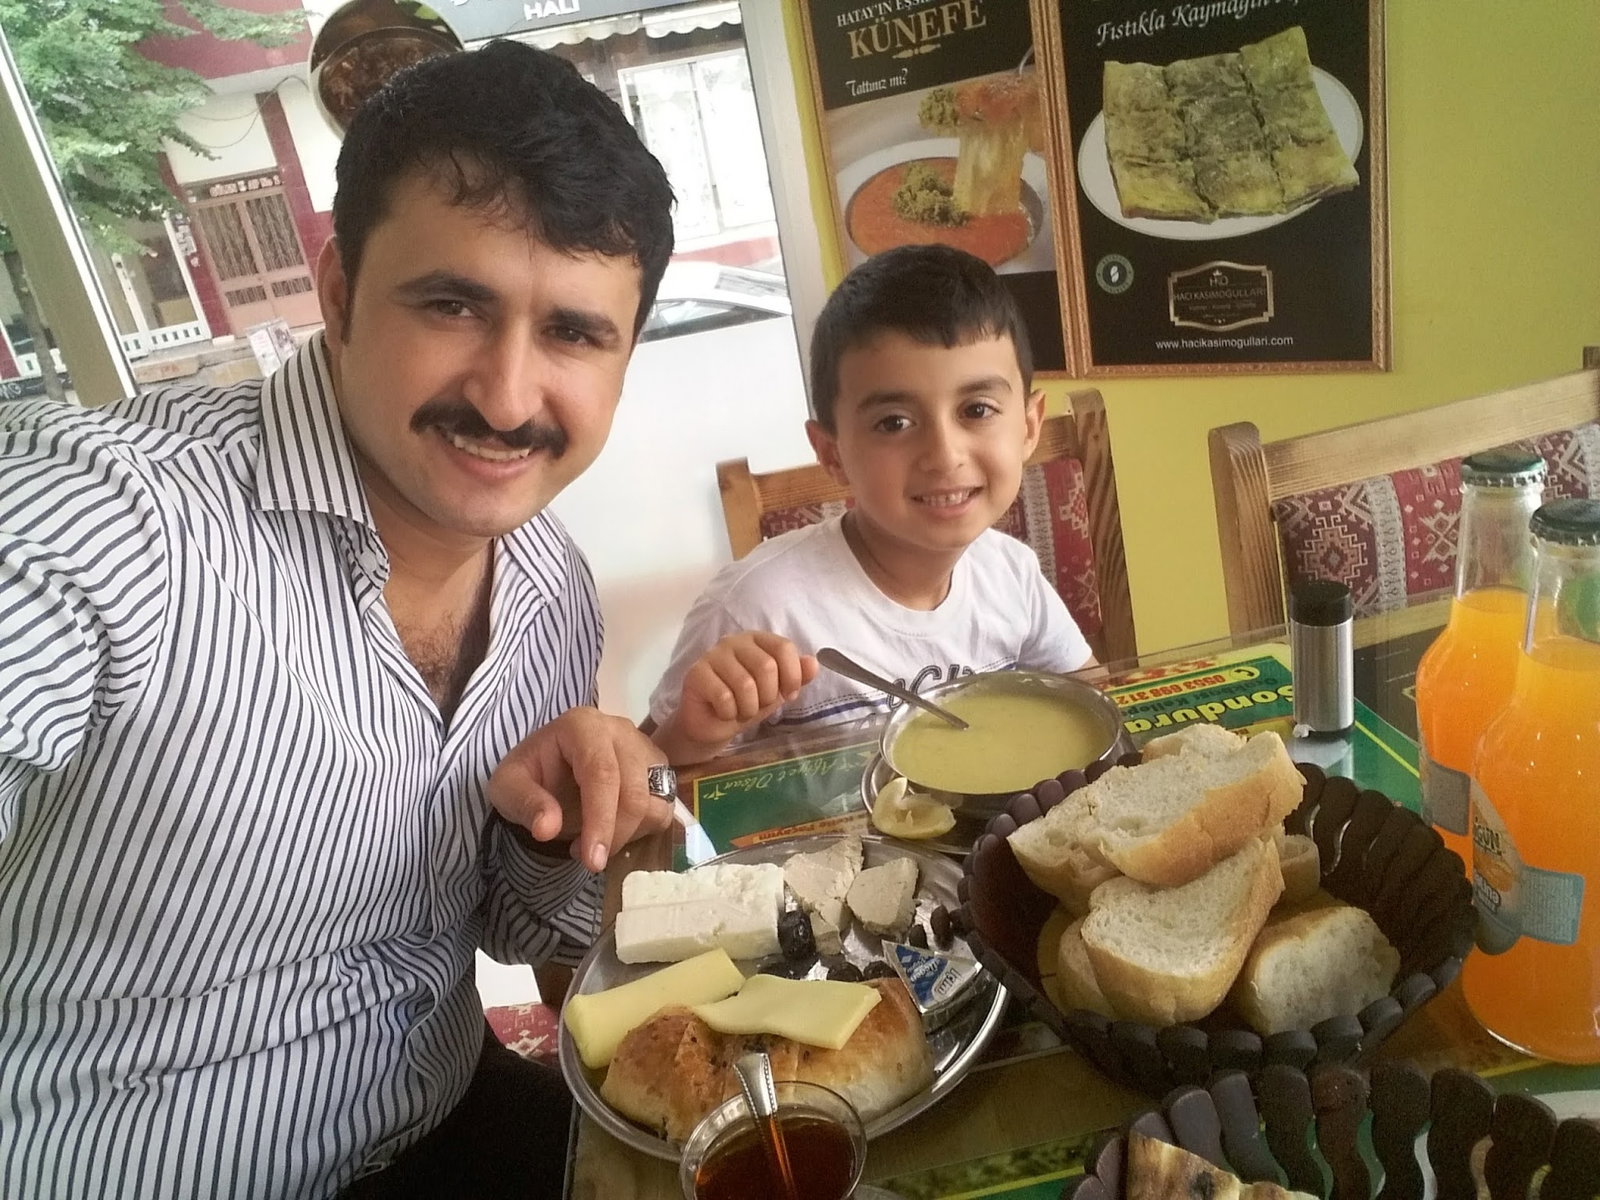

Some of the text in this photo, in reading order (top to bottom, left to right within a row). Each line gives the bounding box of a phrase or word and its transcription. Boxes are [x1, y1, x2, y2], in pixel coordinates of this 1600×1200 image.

[847, 0, 987, 59] KÜNEFE
[1155, 336, 1294, 350] www.hacikasimogullari.com
[1123, 684, 1293, 734] Sondura
